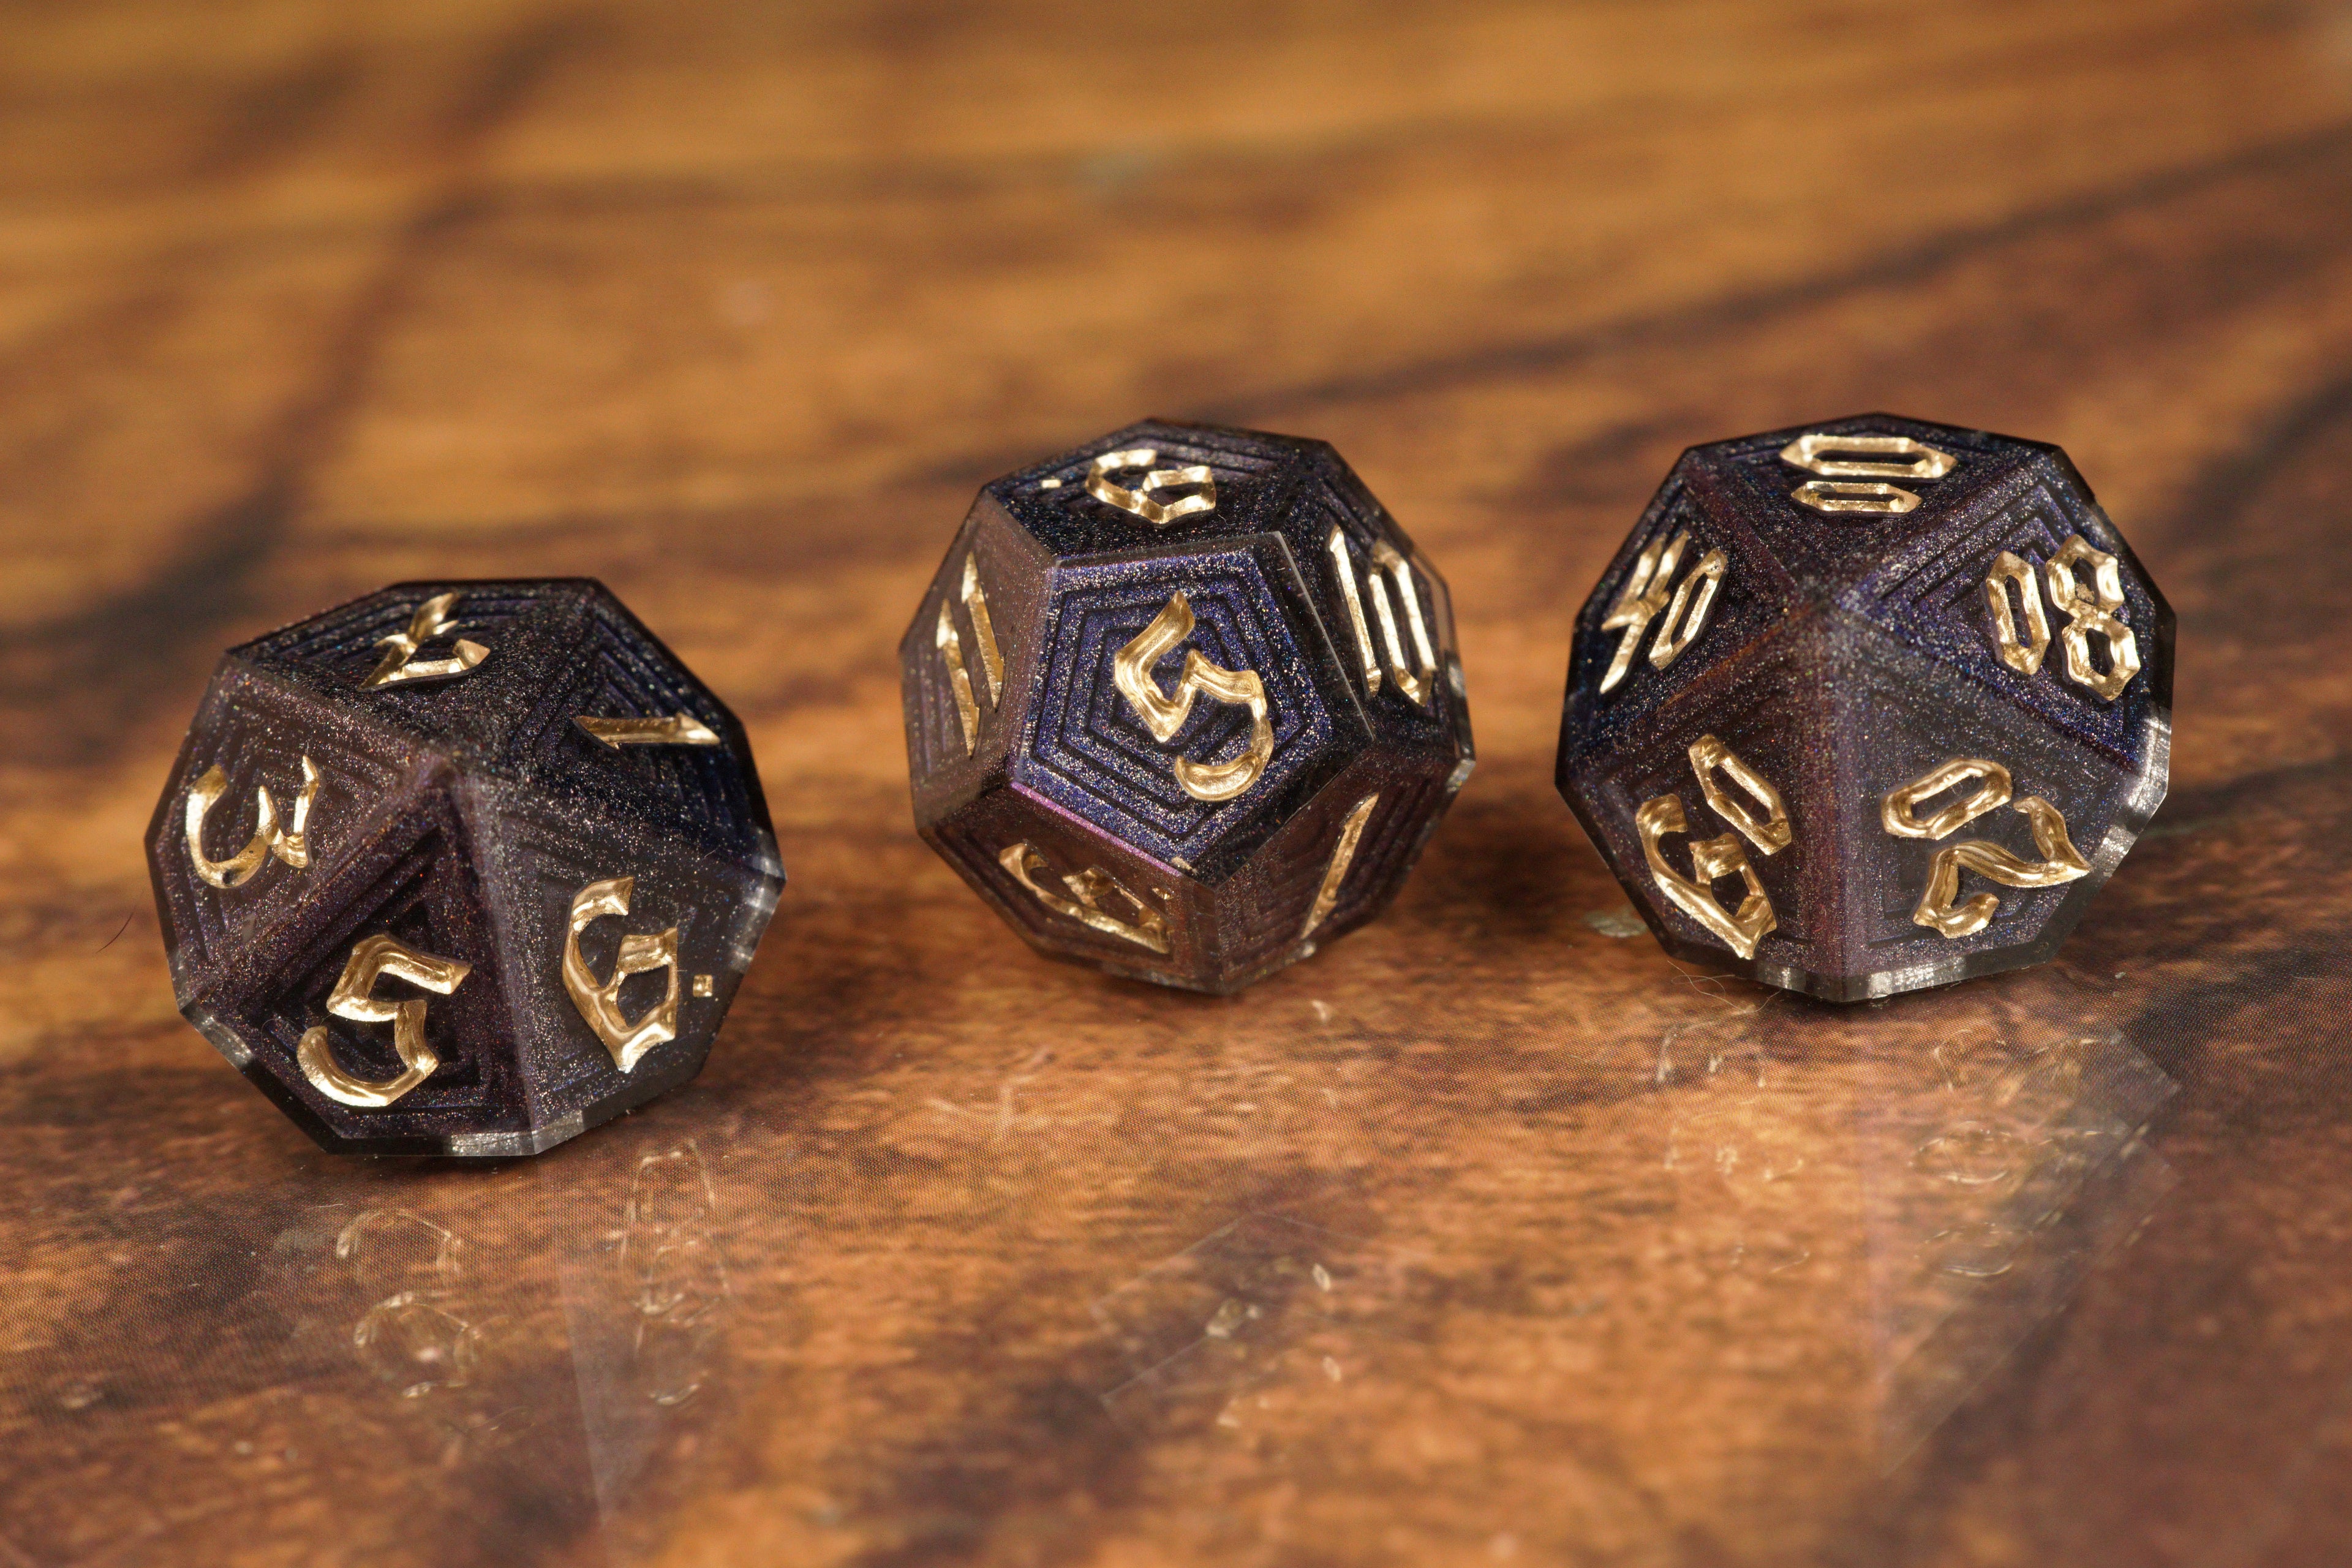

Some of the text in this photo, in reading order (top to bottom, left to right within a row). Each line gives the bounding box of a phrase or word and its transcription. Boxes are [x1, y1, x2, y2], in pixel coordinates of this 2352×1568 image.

[1114, 590, 1274, 801] 5
[1601, 530, 1728, 693] 40
[187, 755, 319, 889] 3
[297, 932, 472, 1107] 5
